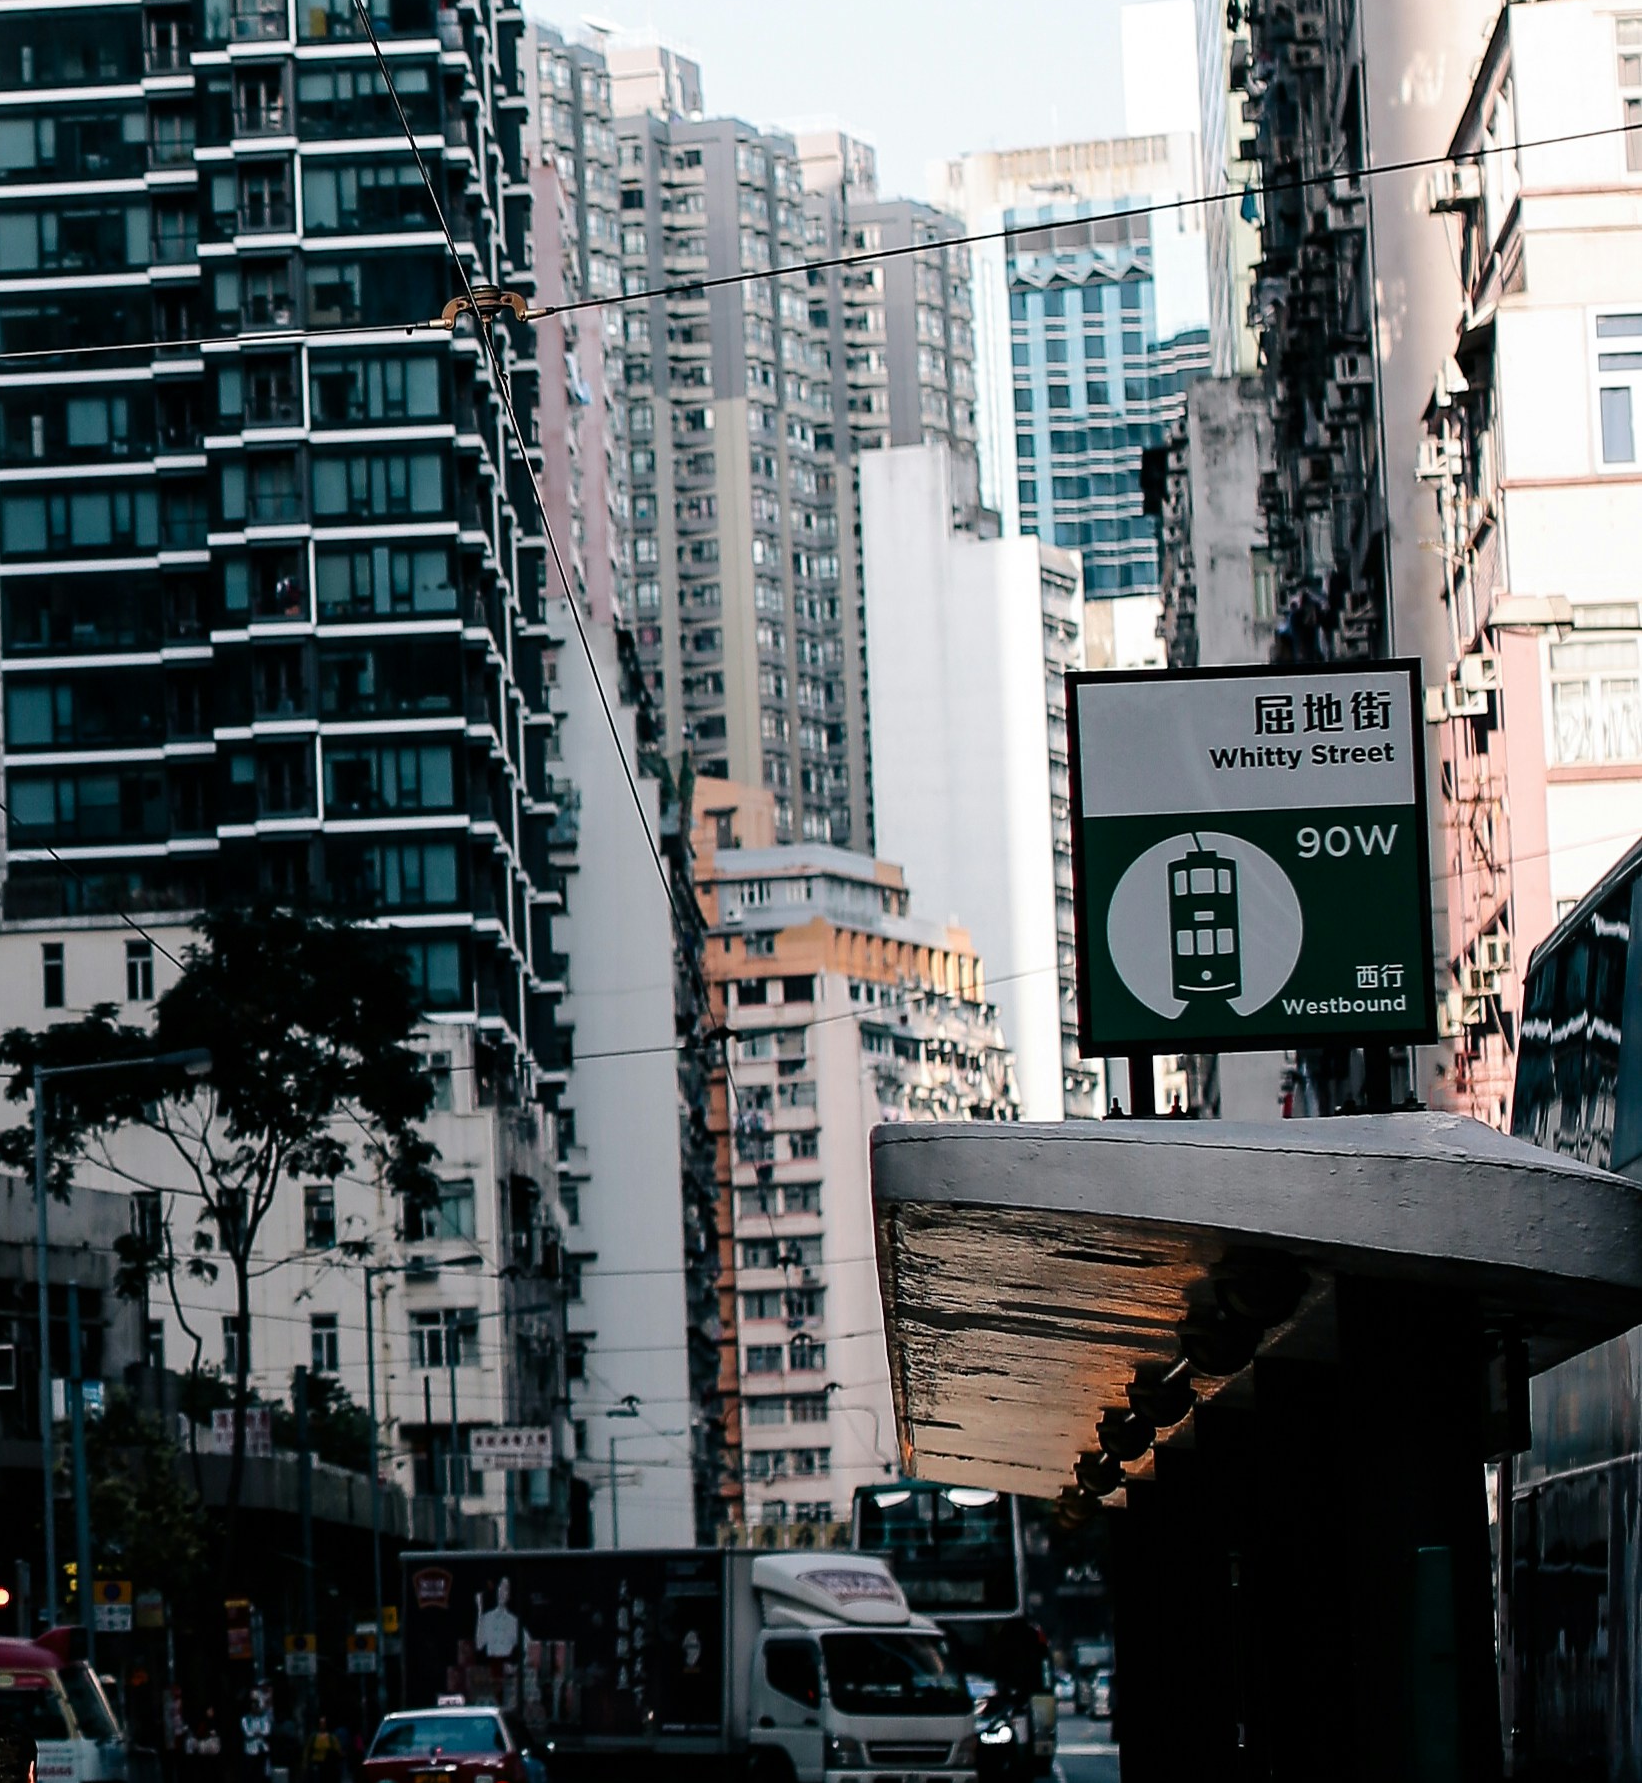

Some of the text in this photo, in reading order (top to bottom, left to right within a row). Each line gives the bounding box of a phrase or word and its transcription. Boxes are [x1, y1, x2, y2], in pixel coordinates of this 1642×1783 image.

[1254, 691, 1392, 735] 屈地街
[1209, 743, 1395, 770] Whitty Street
[1297, 824, 1398, 859] 90W
[1356, 964, 1404, 989] 西行
[1282, 994, 1406, 1015] Westbound
